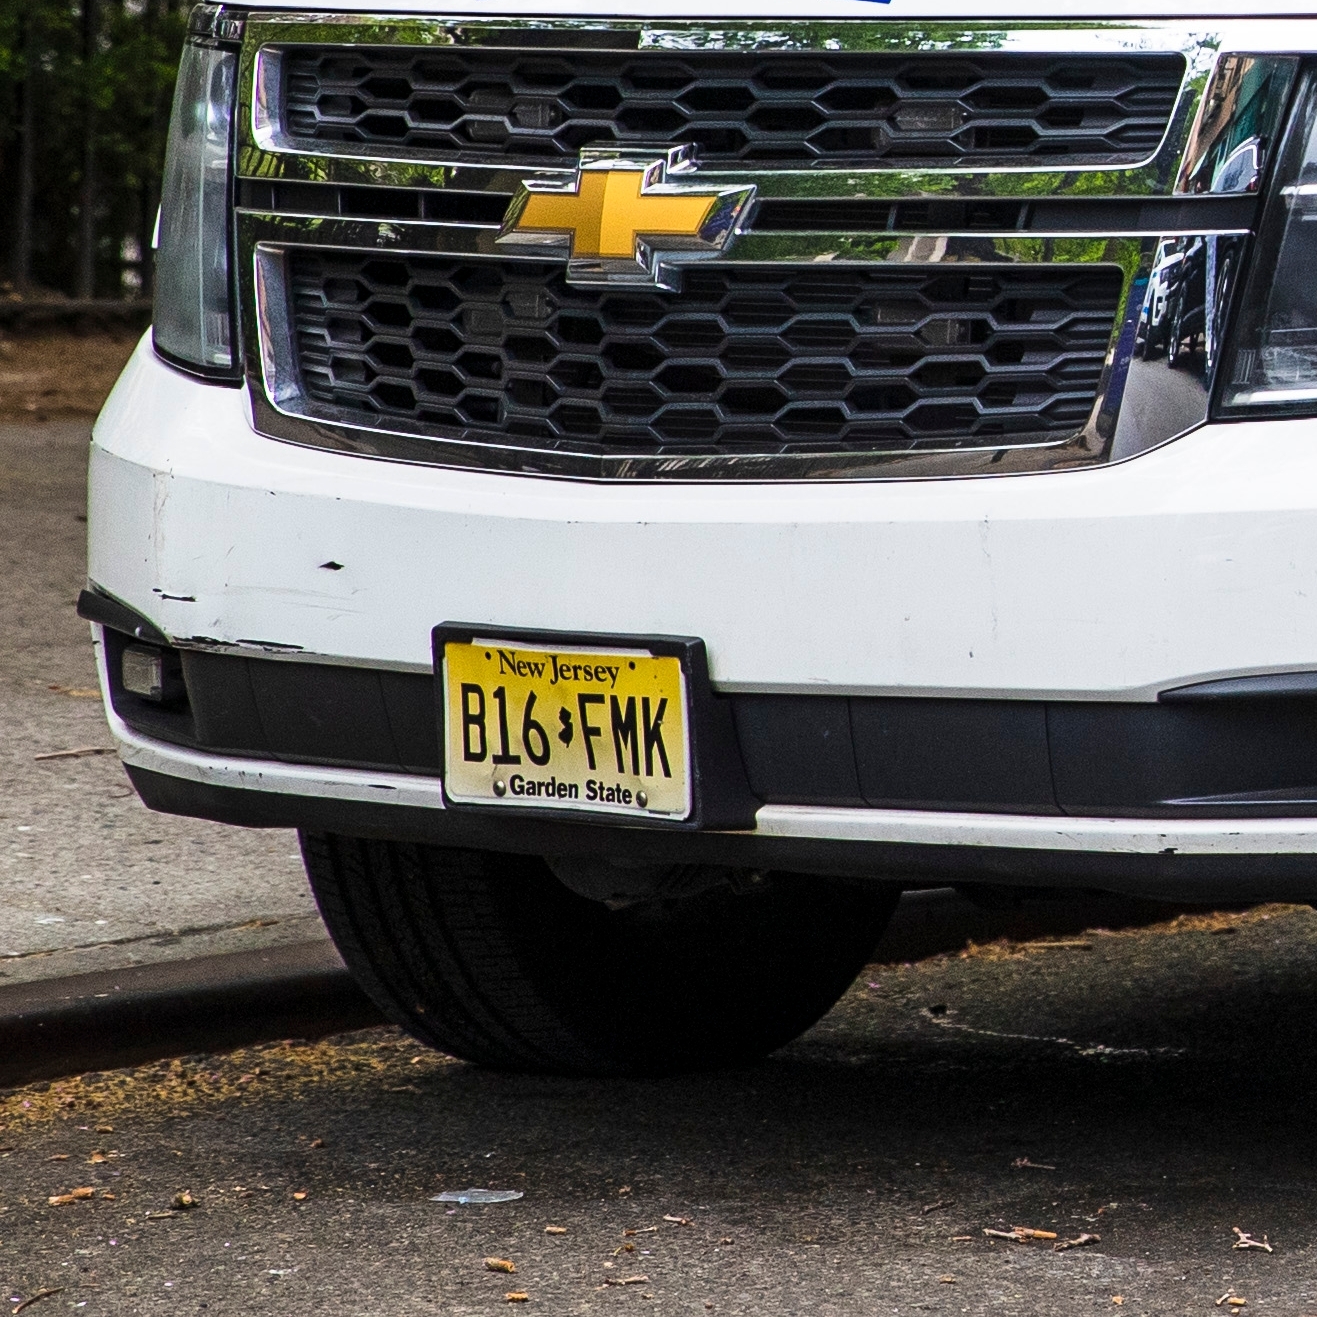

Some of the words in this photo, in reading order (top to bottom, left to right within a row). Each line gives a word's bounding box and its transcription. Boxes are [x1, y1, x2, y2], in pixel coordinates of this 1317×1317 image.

[496, 649, 546, 679] New
[549, 654, 621, 688] Jersey
[460, 682, 551, 766] B16
[577, 692, 673, 778] FMK
[509, 773, 579, 799] Garden
[586, 778, 633, 805] State
